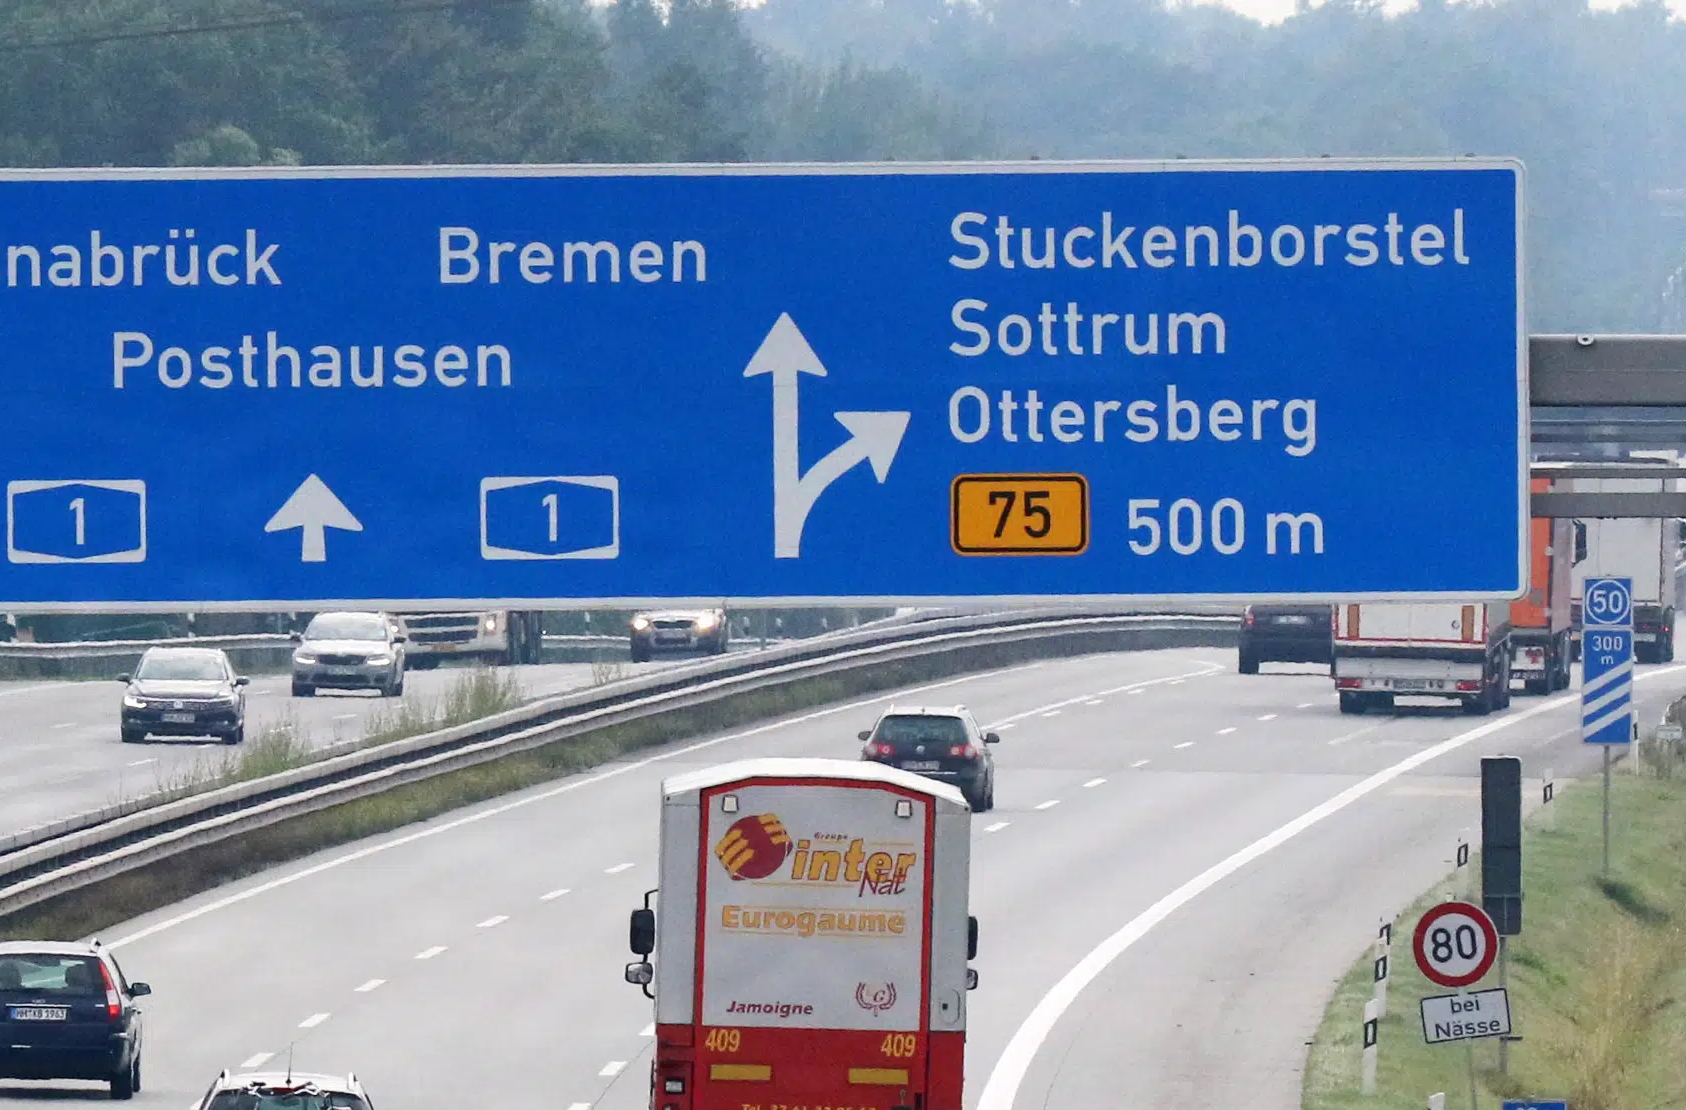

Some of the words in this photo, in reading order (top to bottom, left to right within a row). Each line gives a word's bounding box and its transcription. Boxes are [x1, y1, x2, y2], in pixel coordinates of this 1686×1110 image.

[437, 227, 708, 285] Bremen
[948, 209, 1470, 270] Stuckenborstel
[948, 299, 1227, 356] Sottrum
[112, 331, 513, 390] Posthausen
[948, 384, 1318, 458] Ottersberg
[69, 497, 87, 546] 1
[541, 493, 559, 543] 1
[987, 490, 1052, 540] 75
[1127, 497, 1246, 557] 500
[1265, 509, 1324, 555] m
[1592, 590, 1623, 614] 50
[1592, 635, 1623, 651] 300
[1600, 654, 1614, 665] m
[791, 838, 917, 883] inter
[721, 905, 908, 938] Eurogaume
[1431, 924, 1478, 963] 80
[726, 1000, 814, 1018] Jamoigne
[1450, 995, 1481, 1014] bei
[705, 1029, 740, 1053] 409
[881, 1034, 916, 1058] 409
[1435, 1020, 1501, 1039] Nässe
